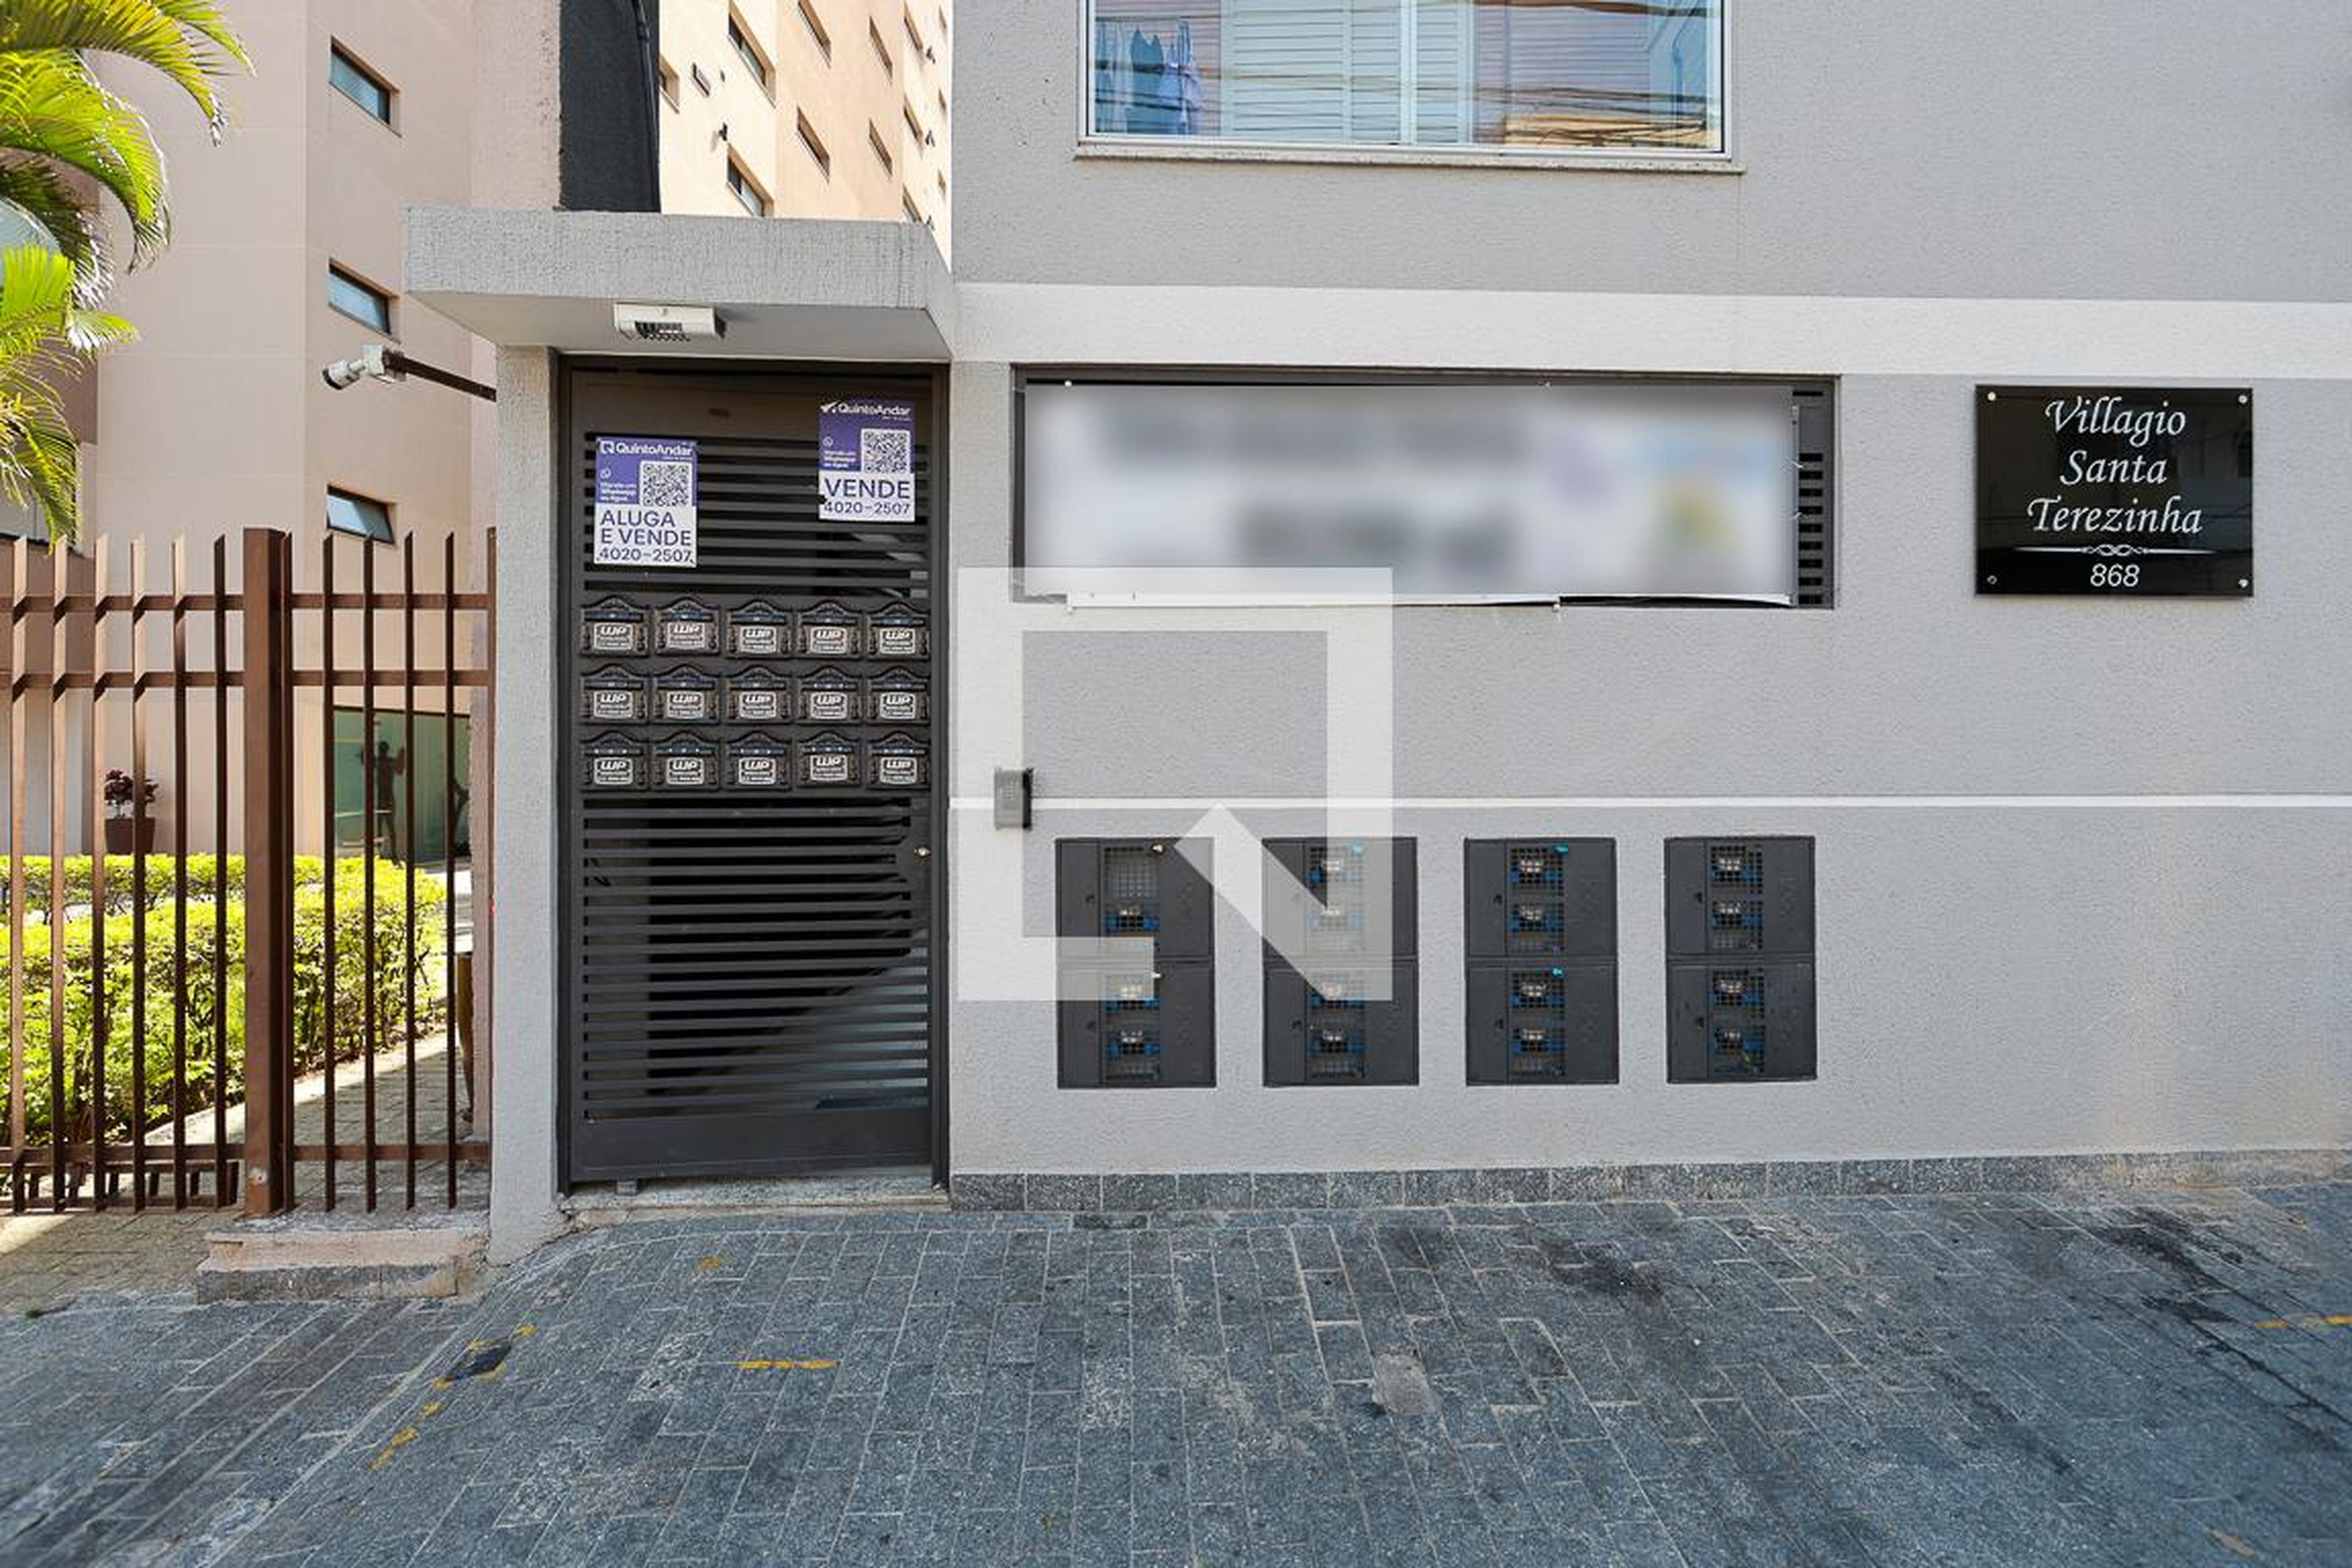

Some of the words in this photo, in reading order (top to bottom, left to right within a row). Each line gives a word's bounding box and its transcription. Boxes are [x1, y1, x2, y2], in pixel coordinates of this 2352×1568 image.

[2045, 395, 2187, 447] Villagio
[616, 442, 693, 455] QuintoAndar
[2059, 450, 2168, 486] Santa
[824, 478, 911, 499] VENDE
[600, 510, 676, 527] ALUGA
[2027, 495, 2203, 534] Terezinha
[601, 528, 613, 544] E
[619, 529, 692, 546] VENDE
[2089, 564, 2140, 587] 868
